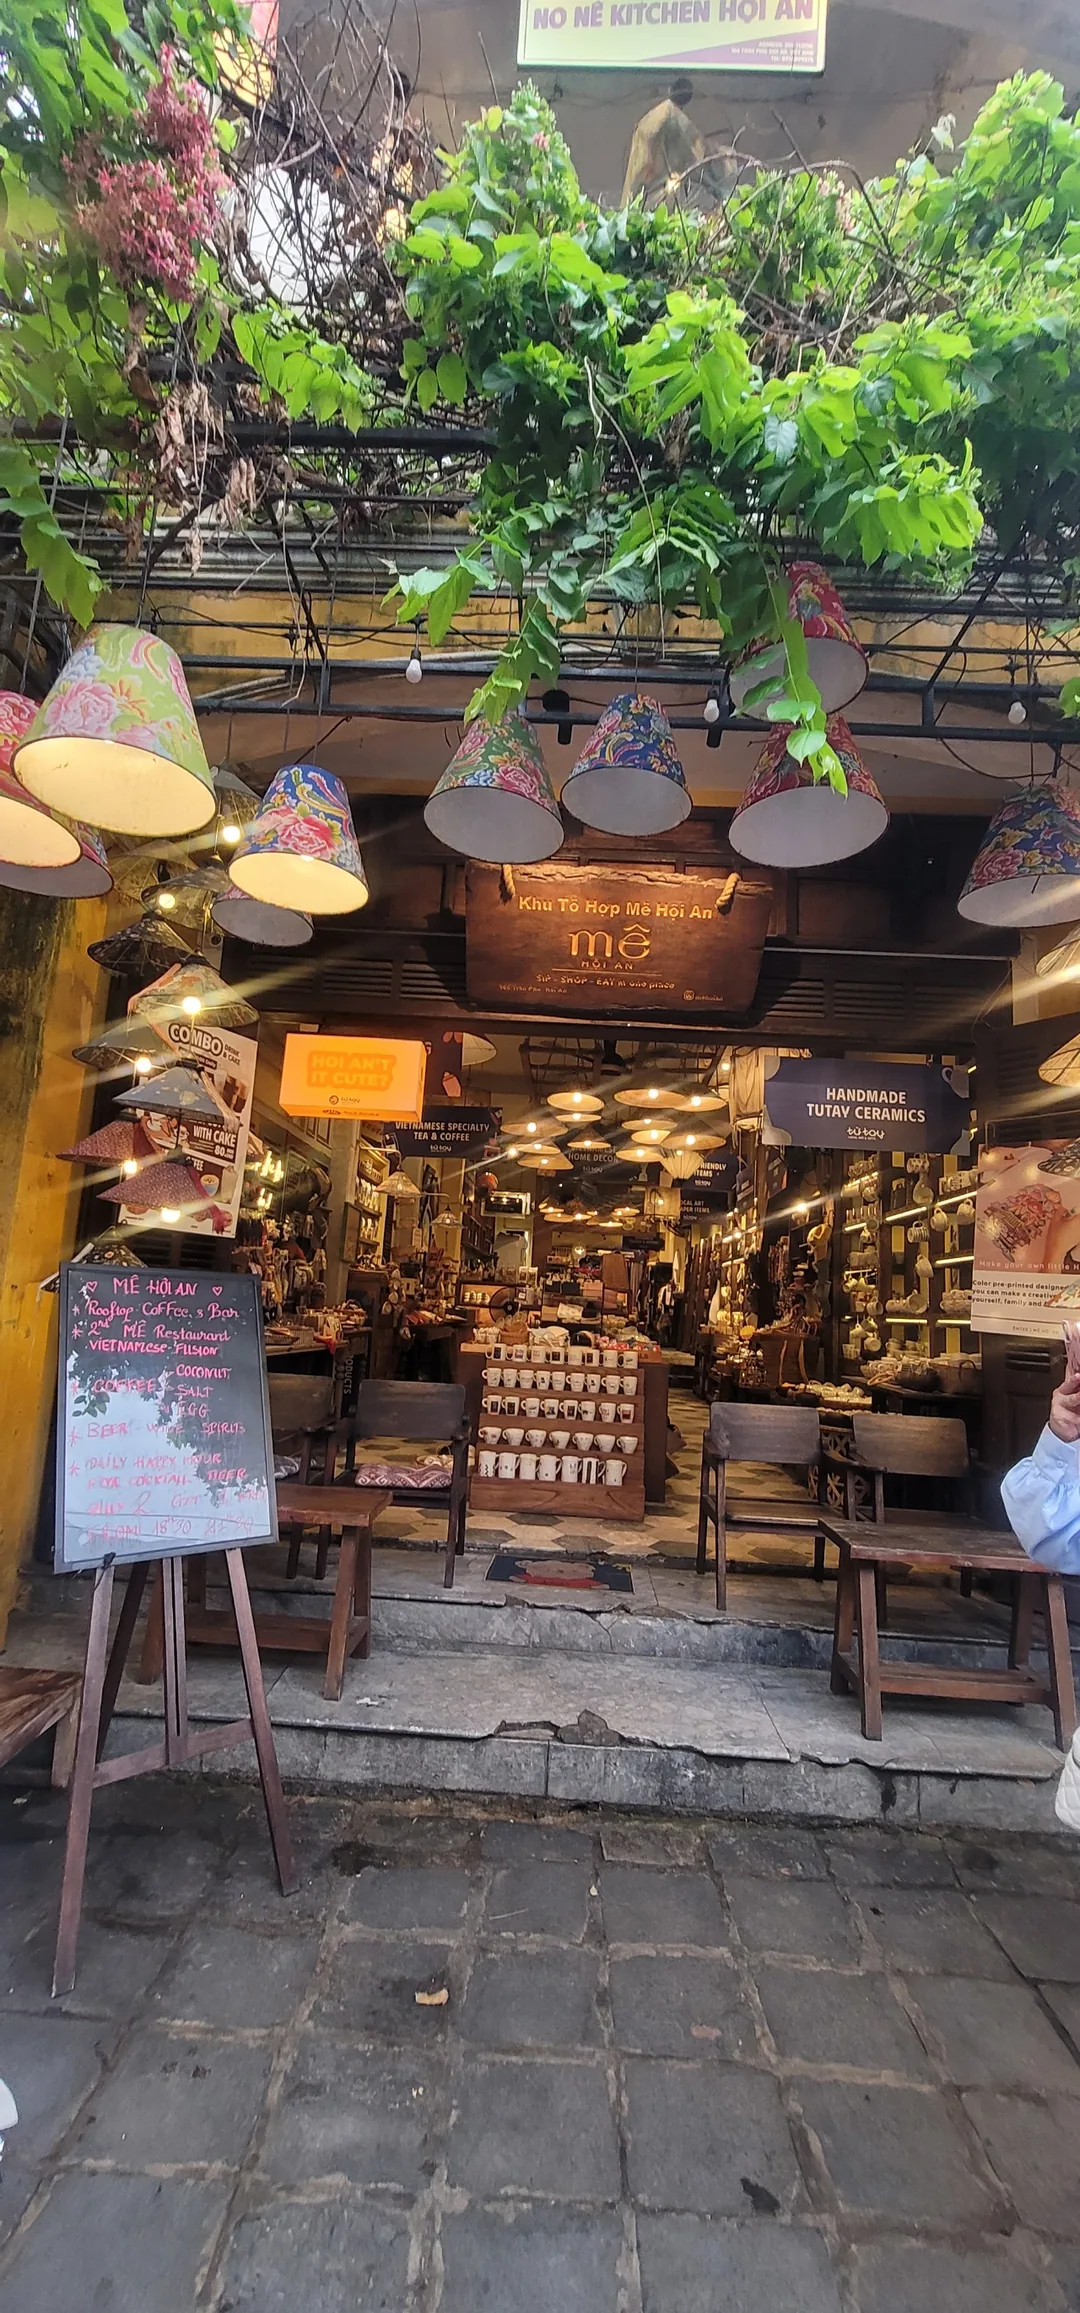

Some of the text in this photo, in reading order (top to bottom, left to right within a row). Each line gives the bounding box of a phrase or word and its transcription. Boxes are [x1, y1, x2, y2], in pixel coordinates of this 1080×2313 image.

[533, 6, 567, 30] NO
[610, 0, 710, 26] KITCHEN
[775, 0, 813, 20] AN
[518, 896, 553, 911] Khu
[585, 900, 621, 918] Hợp
[626, 901, 652, 917] Mê
[655, 902, 685, 922] Hội
[689, 905, 713, 919] An
[568, 923, 651, 959] mê
[614, 962, 633, 970] AN
[560, 975, 588, 985] SHOP
[596, 977, 615, 986] EAT
[649, 981, 675, 990] place
[168, 1023, 223, 1056] COMBO
[312, 1055, 344, 1068] HOI
[312, 1071, 388, 1087] IT CUTE?
[826, 1087, 907, 1105] HANDMADE
[807, 1103, 926, 1123] TUTAY CERAMICS
[395, 1121, 490, 1132] VIETNAMESE SPECIALTY
[193, 1125, 212, 1141] WITH
[213, 1130, 237, 1147] CAKE
[414, 1132, 470, 1141] TEA & COFFEE
[568, 1152, 591, 1161] HOME
[113, 1274, 198, 1298] MÊ HỘI AN
[993, 1281, 1034, 1289] pre-printed
[1004, 1298, 1027, 1306] family
[88, 1301, 134, 1324] Rooftop
[208, 1303, 240, 1321] Bar
[88, 1319, 231, 1342] 2nd MÊ Restaurant
[176, 1363, 232, 1379] COCONUT
[92, 1378, 213, 1399] COFFEE SALT
[177, 1401, 211, 1417] EGG
[87, 1422, 128, 1438] BEER
[133, 1490, 152, 1515] 2
